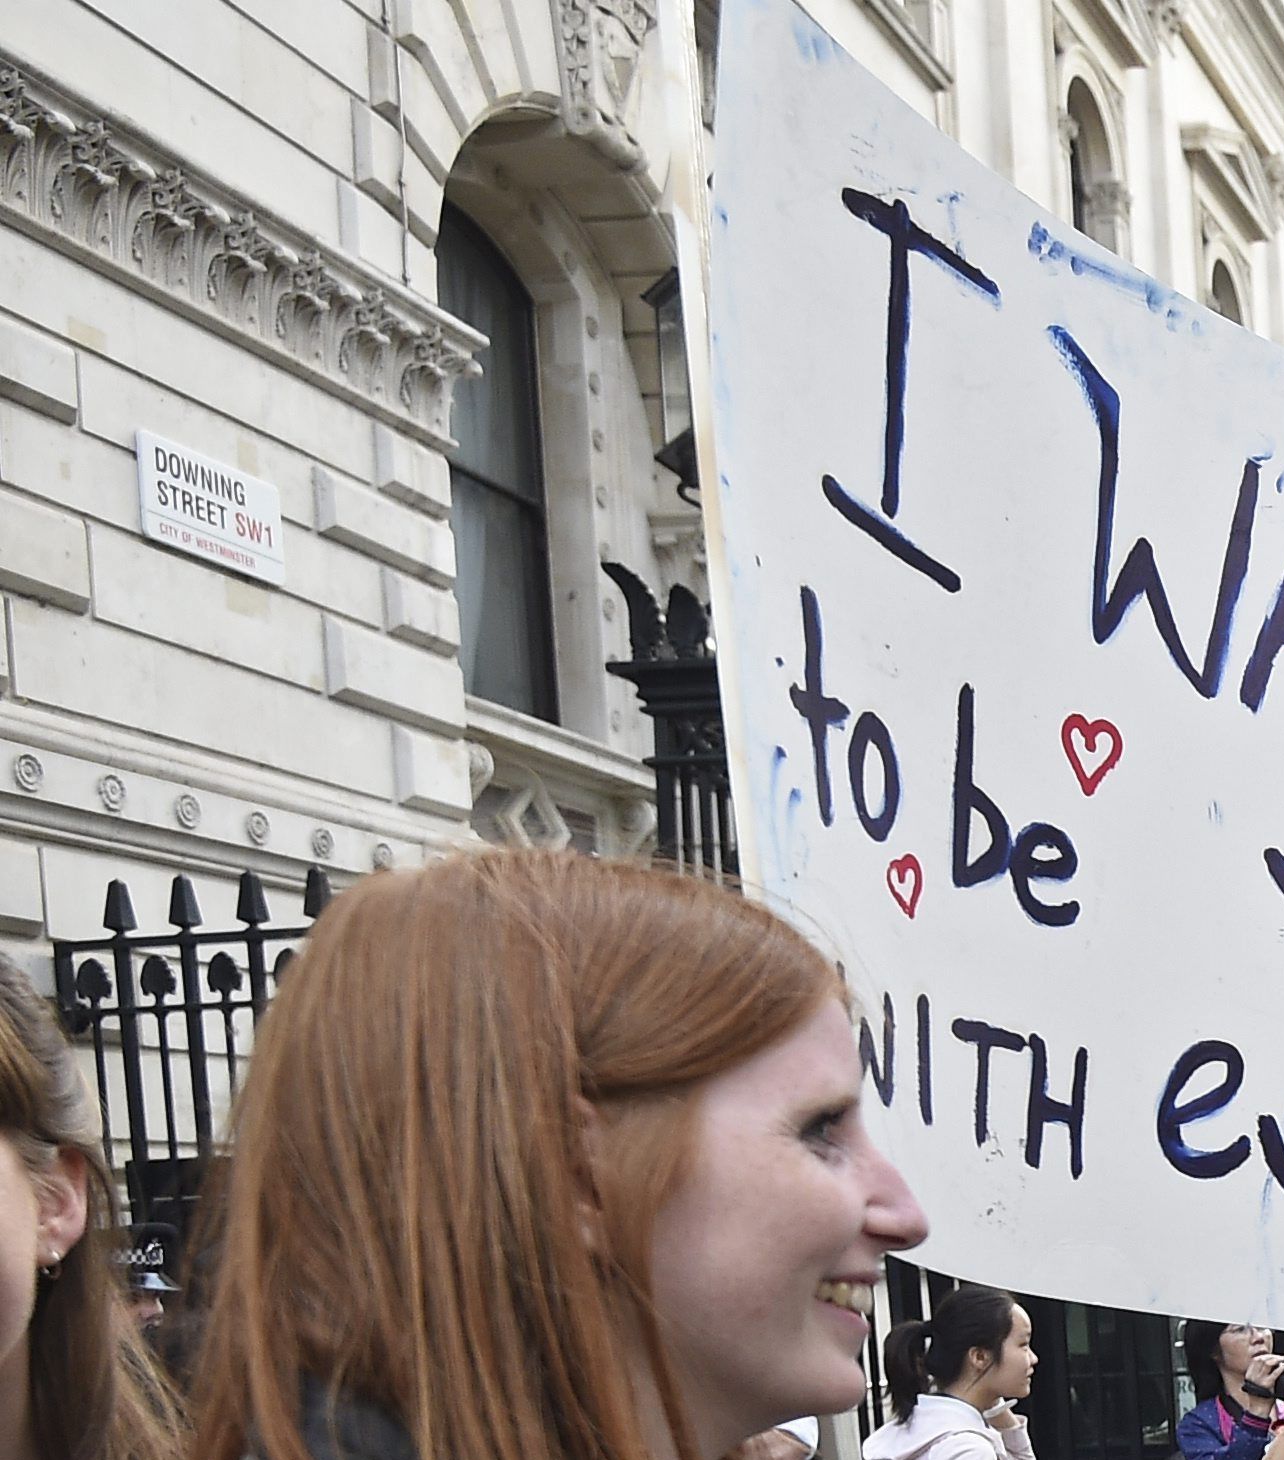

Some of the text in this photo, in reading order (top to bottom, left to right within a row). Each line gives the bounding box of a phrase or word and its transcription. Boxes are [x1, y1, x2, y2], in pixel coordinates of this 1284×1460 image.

[822, 187, 1000, 594] I
[155, 446, 246, 506] DOWNING
[157, 480, 273, 548] STREET SW1
[159, 522, 256, 568] CITY OF WESTMINSTER
[789, 584, 1081, 927] to be
